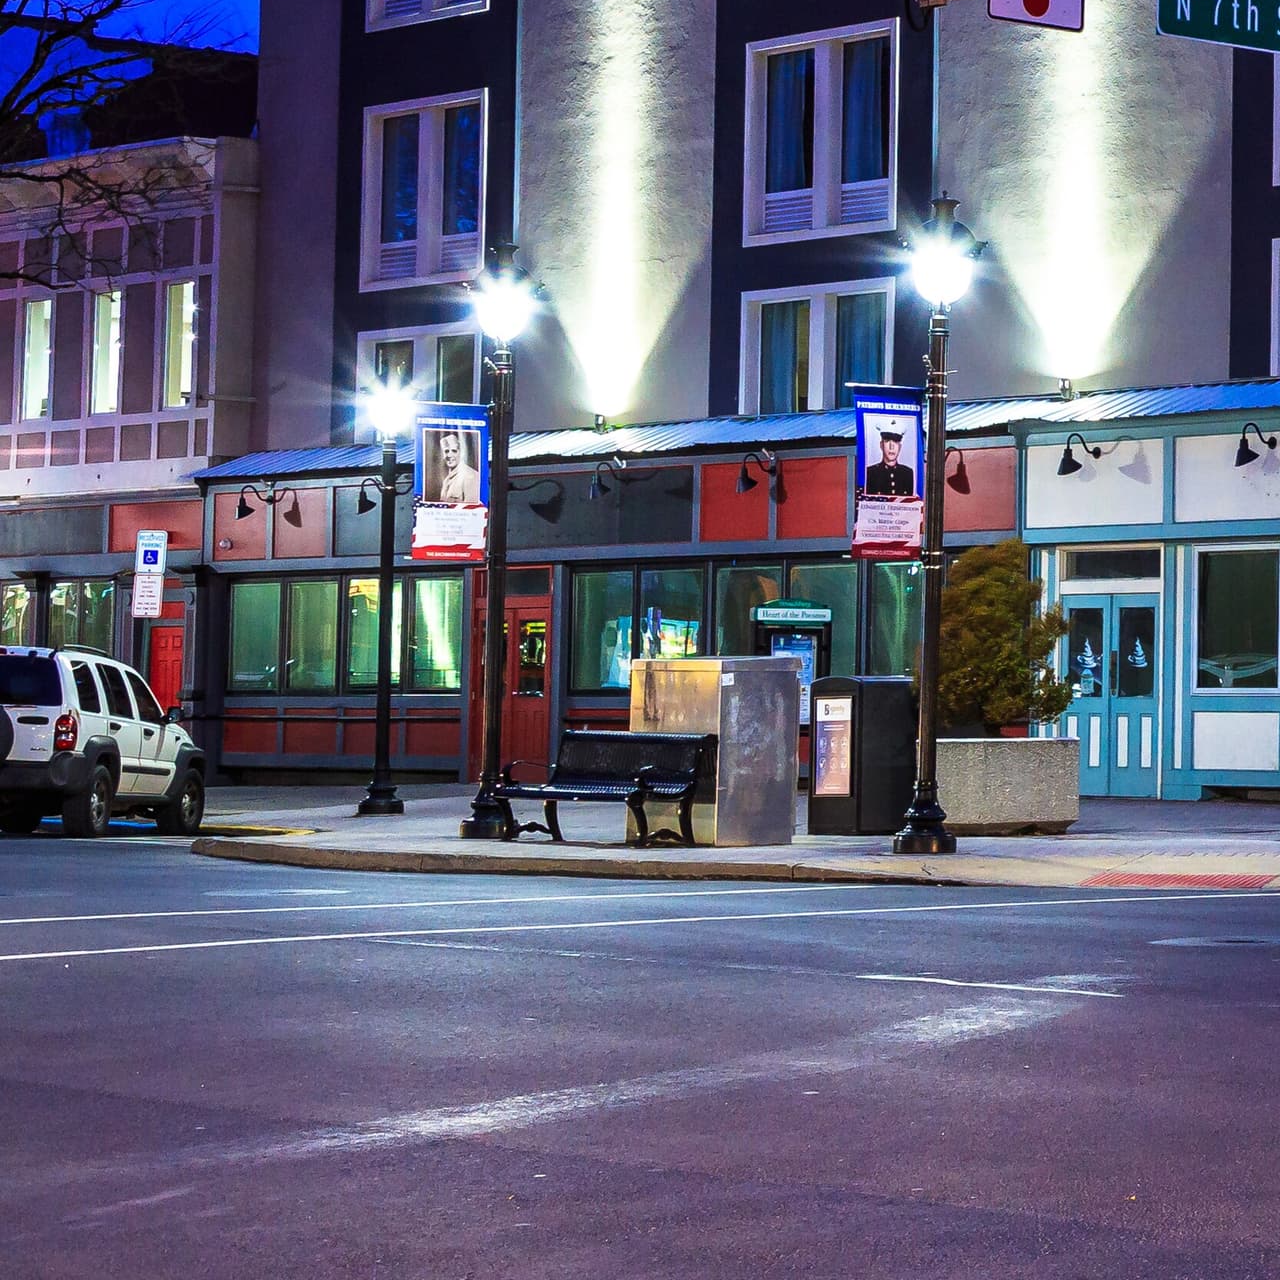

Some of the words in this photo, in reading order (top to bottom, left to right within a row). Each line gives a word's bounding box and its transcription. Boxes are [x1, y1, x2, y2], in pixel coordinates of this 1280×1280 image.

[762, 609, 781, 618] Heart
[782, 609, 788, 618] of
[790, 609, 799, 618] the
